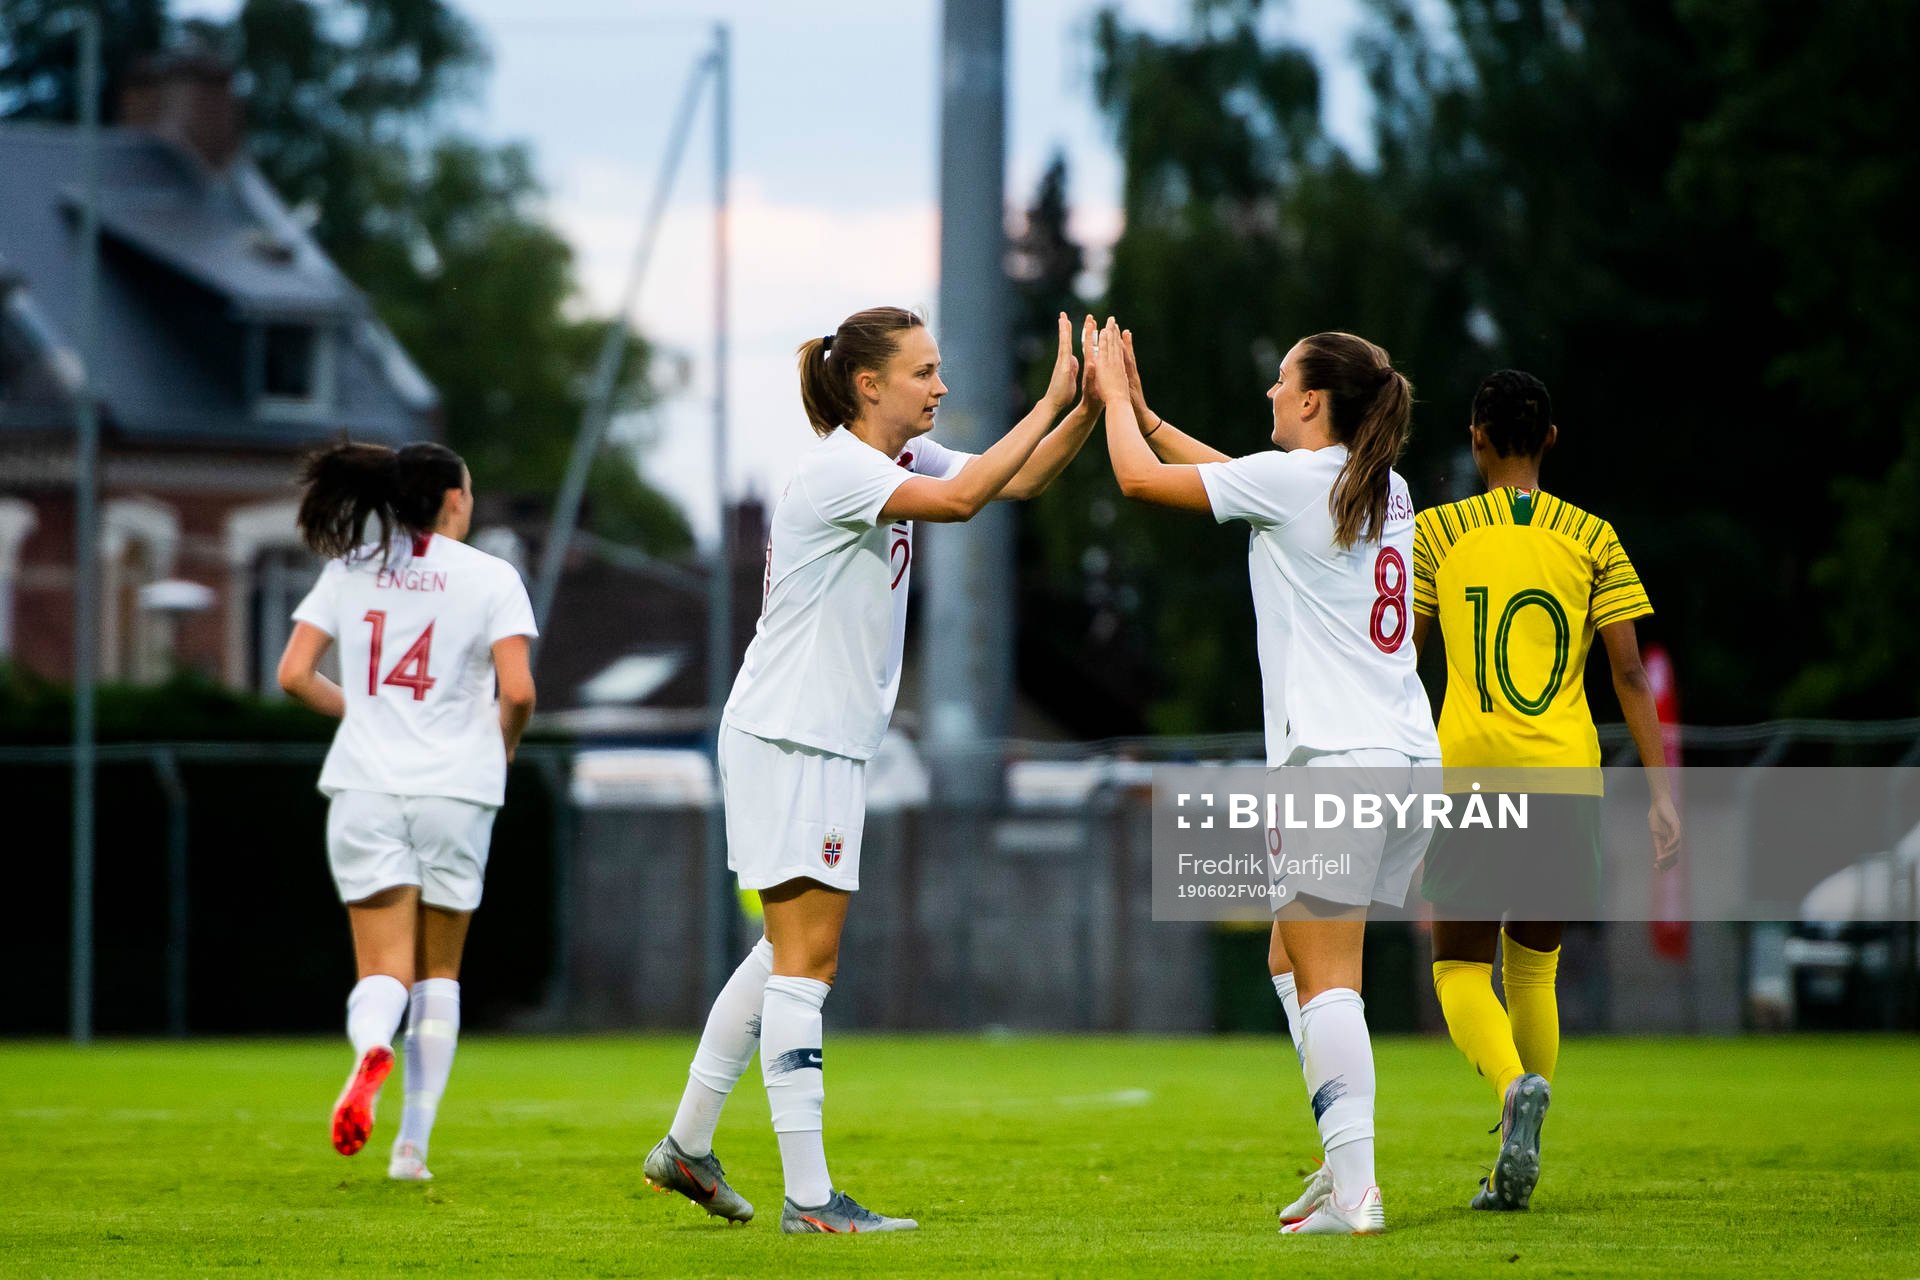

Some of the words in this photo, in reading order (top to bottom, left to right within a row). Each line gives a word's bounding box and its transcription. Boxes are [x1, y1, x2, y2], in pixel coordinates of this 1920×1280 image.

[376, 568, 447, 592] ENGEN
[1370, 546, 1406, 654] 8
[363, 609, 437, 701] 14
[1465, 586, 1570, 716] 10
